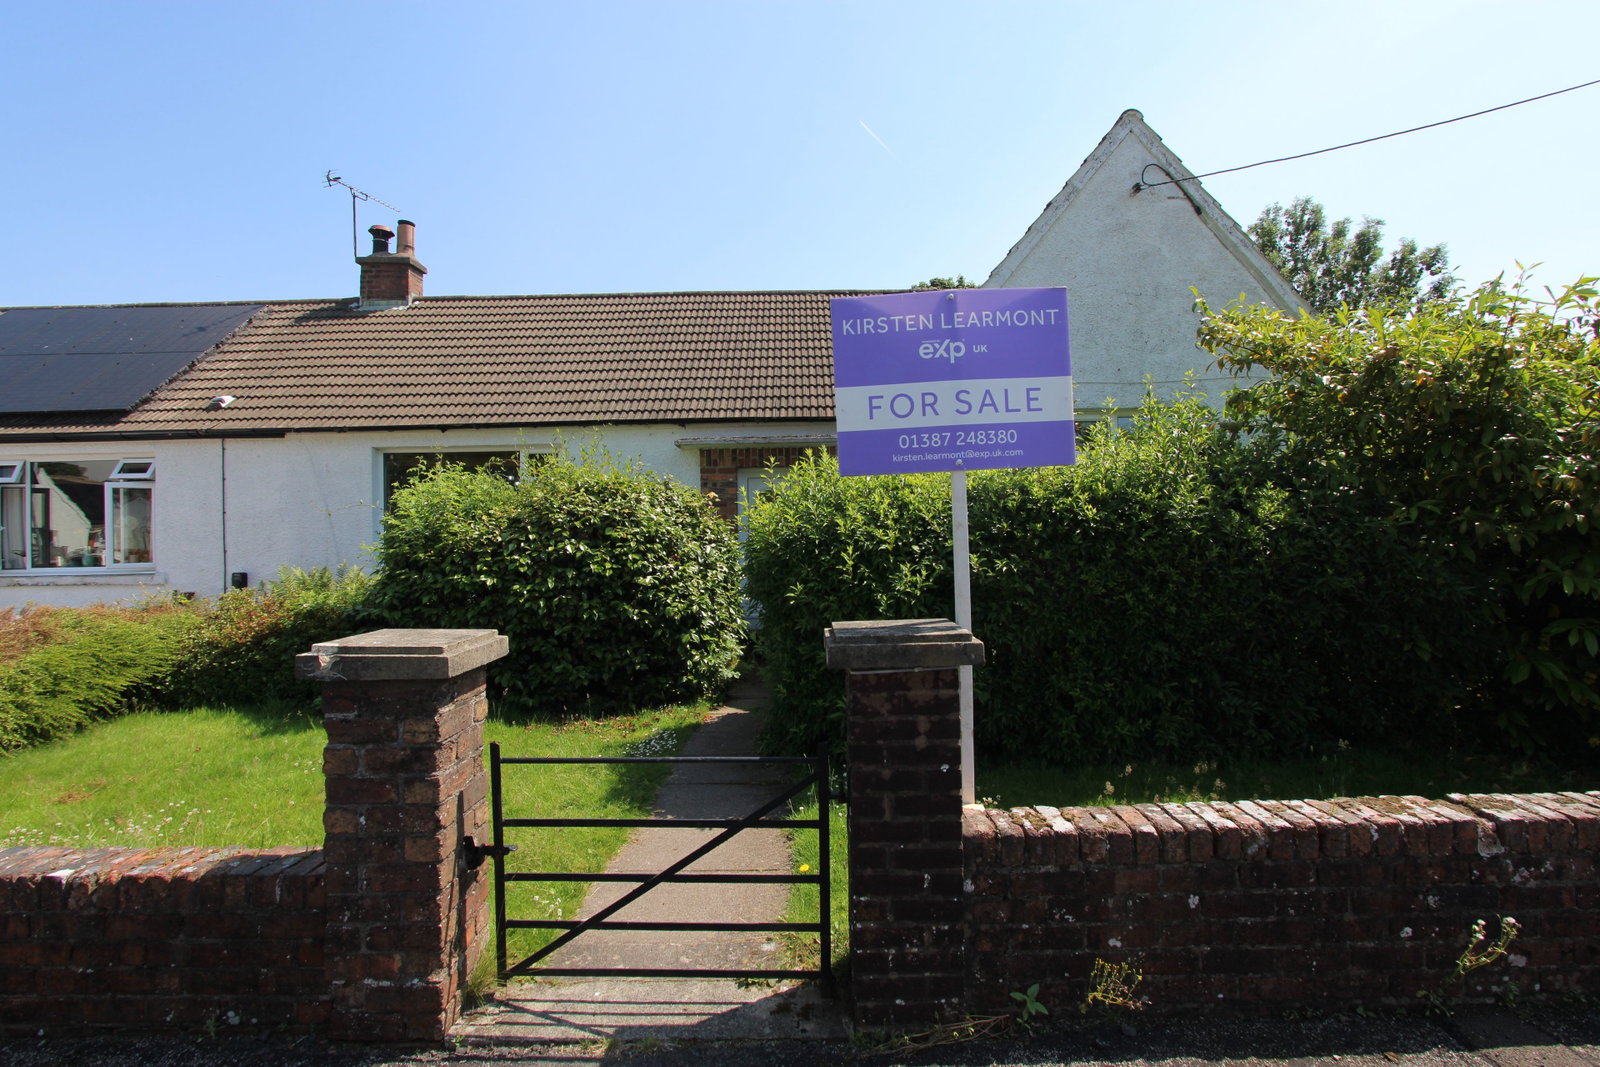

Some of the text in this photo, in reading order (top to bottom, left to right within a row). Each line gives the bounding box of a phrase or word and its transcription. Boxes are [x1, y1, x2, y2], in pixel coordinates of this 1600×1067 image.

[842, 309, 1059, 336] KIRSTEN LEARMONT
[973, 344, 988, 353] UK
[868, 387, 1043, 420] FOR SALE
[899, 429, 1018, 449] 01387 248380
[892, 449, 1024, 463] kirsten.learmont@exp.uk.com
